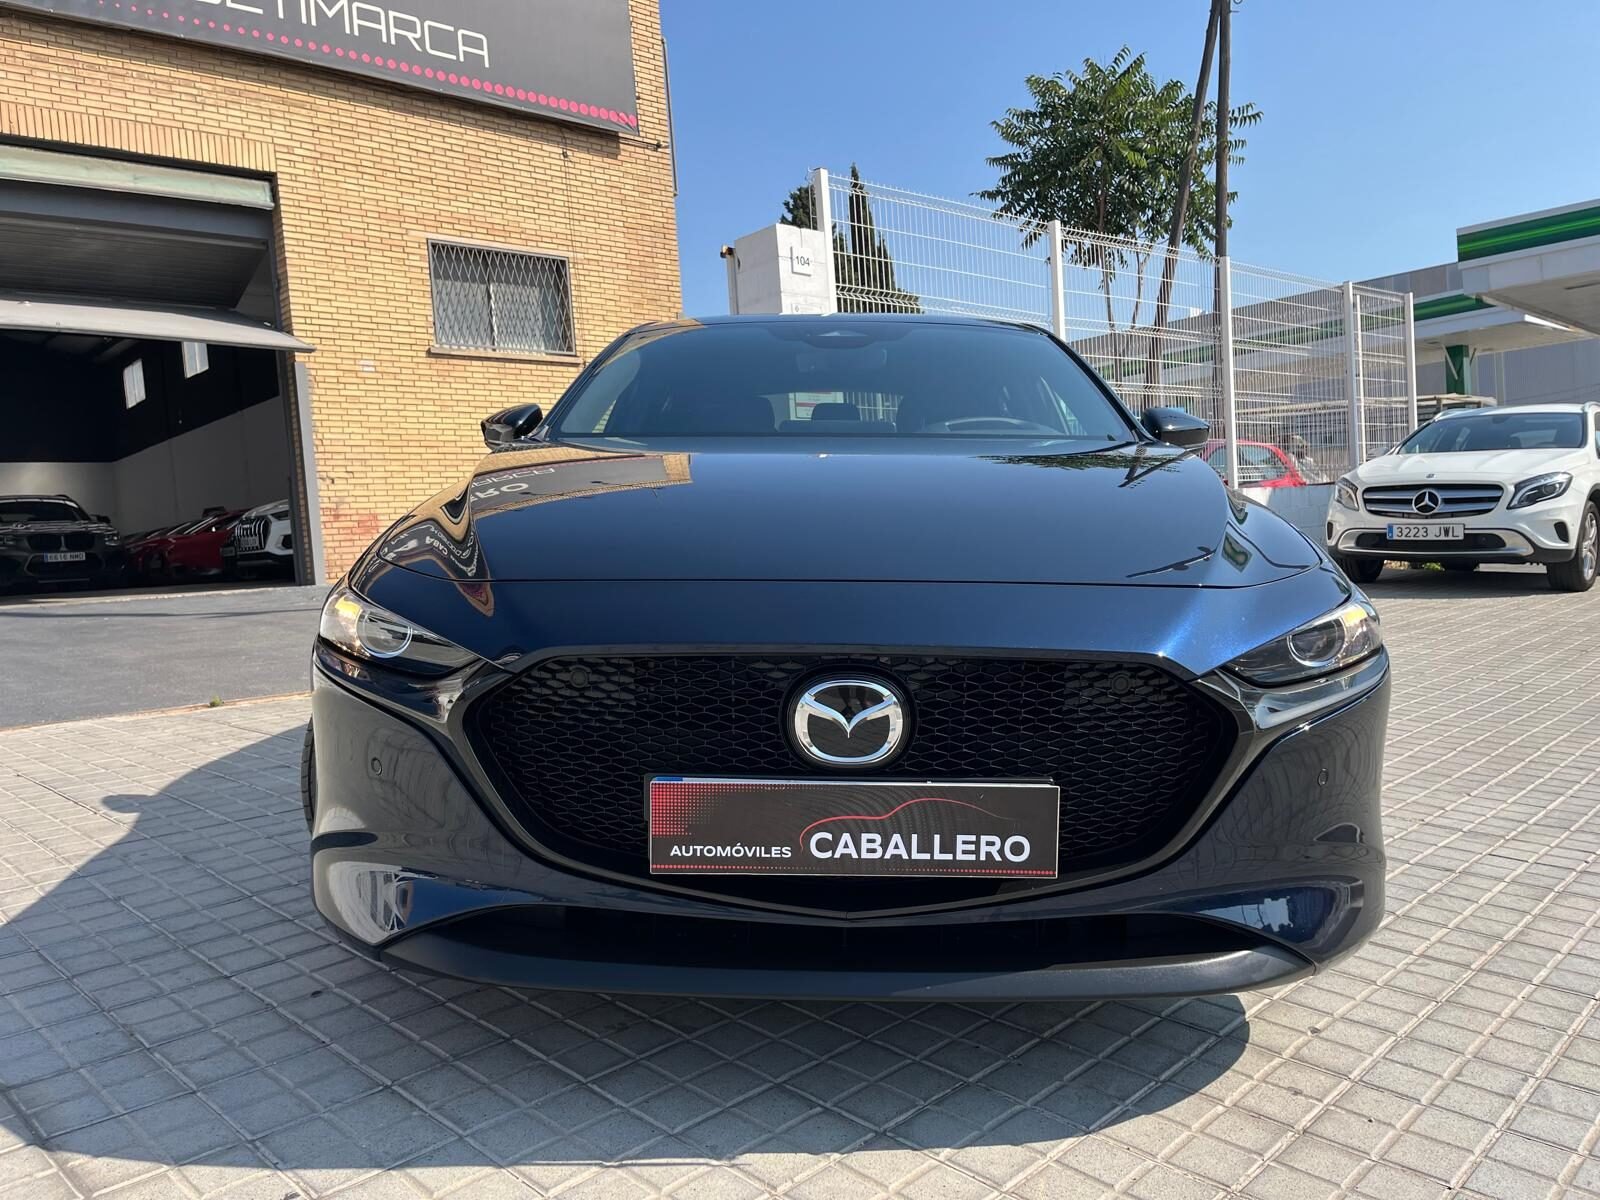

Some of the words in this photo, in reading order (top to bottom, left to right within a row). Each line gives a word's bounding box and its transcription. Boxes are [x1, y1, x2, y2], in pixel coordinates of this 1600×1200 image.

[196, 0, 490, 68] IMARCA
[795, 255, 810, 267] 104
[1396, 526, 1429, 538] 3223
[1434, 526, 1460, 538] JWL
[670, 842, 792, 858] AUTOMÓVILES
[809, 831, 1031, 863] CABALLERO
